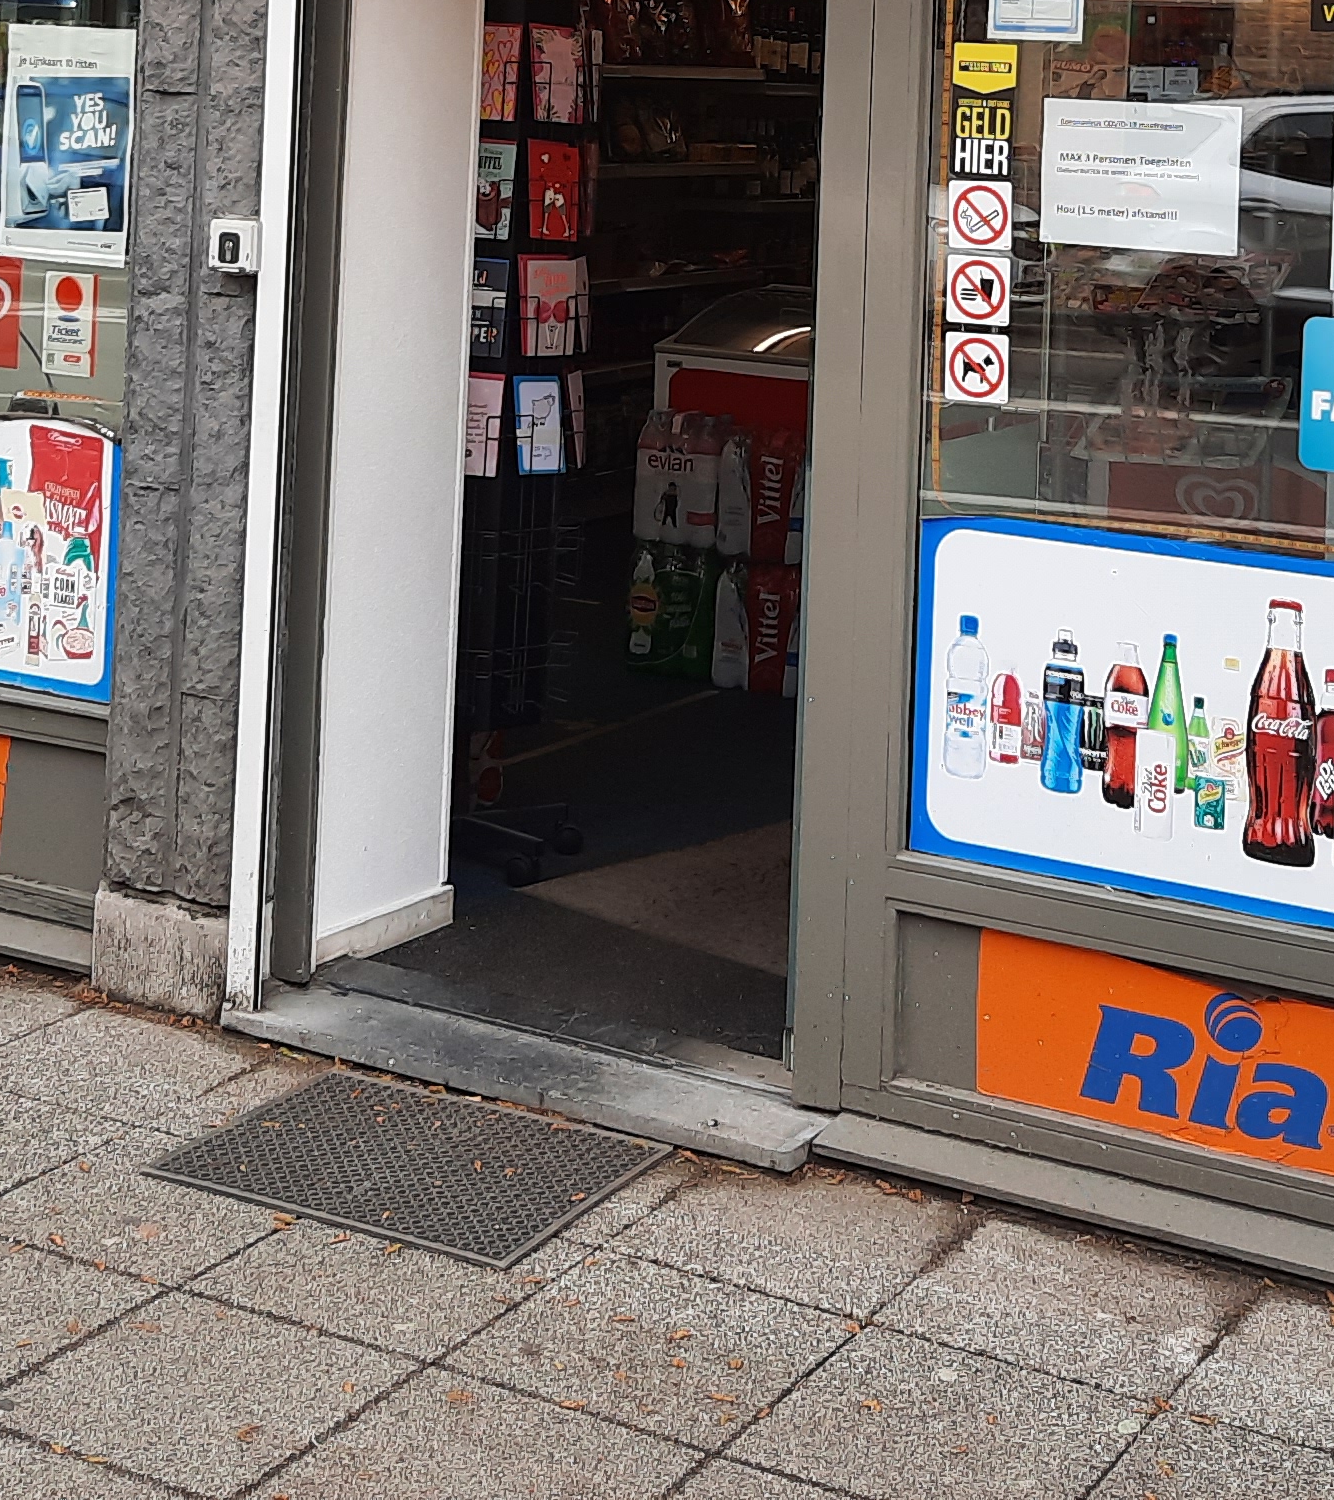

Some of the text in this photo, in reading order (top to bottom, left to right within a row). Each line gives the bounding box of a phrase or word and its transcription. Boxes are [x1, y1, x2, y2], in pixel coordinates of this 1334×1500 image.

[74, 93, 103, 112] YES
[60, 124, 116, 150] SCAN!
[71, 110, 106, 131] YOU
[956, 106, 1010, 140] GELD
[955, 138, 1009, 175] HIER
[648, 454, 693, 472] evian
[757, 456, 785, 525] Vittel
[755, 592, 781, 663] Vittel
[1111, 701, 1138, 716] Coke
[1148, 763, 1167, 813] Coke
[1079, 991, 1330, 1150] Ria
